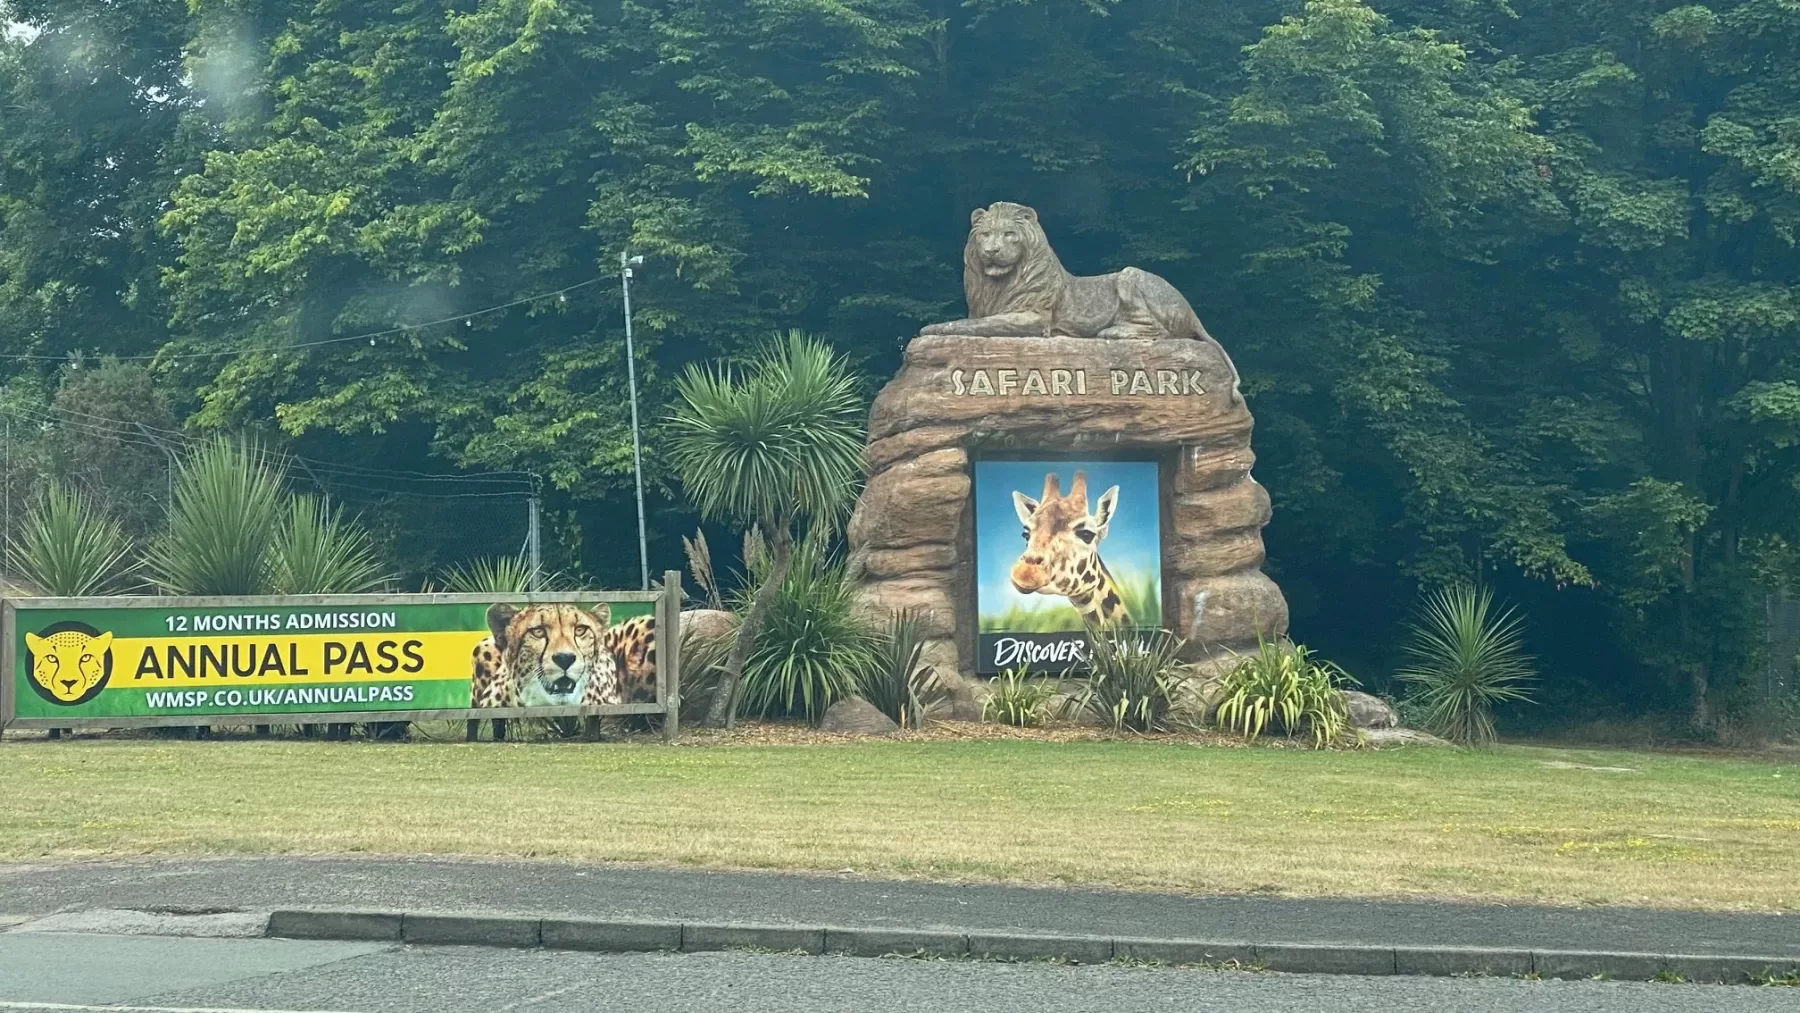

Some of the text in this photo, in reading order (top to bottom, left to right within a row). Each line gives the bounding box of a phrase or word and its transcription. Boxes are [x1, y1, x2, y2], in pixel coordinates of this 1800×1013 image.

[951, 368, 1207, 396] SAFARI PARK
[165, 612, 397, 632] 12 MONTHS ADMISSION
[134, 639, 424, 680] ANNUAL PASS
[146, 685, 414, 708] WMSP.CO.UK/ANNUALPASS
